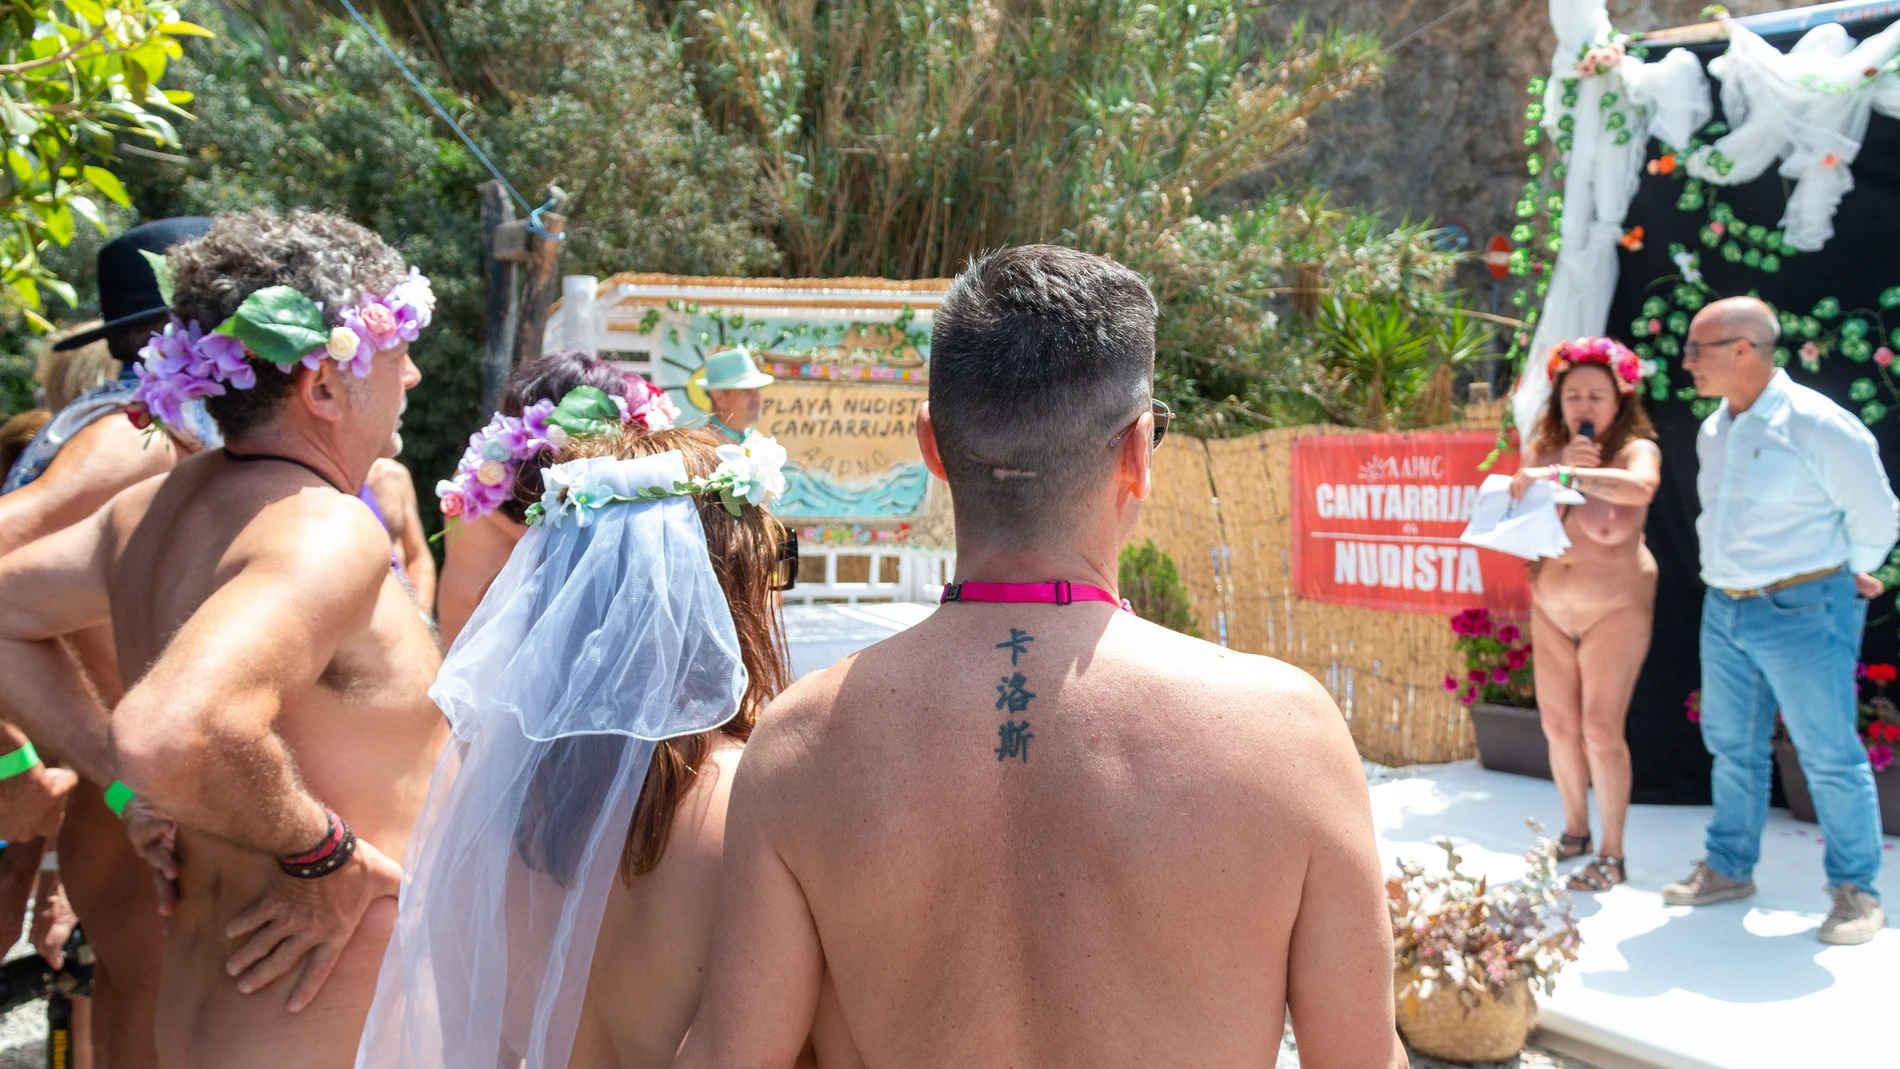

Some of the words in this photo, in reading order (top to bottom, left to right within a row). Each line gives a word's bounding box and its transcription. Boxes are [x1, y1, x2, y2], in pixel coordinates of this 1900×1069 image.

[762, 397, 832, 415] PLAYA
[844, 397, 922, 415] NUDIST
[1315, 482, 1478, 523] CANTARRIJA
[1334, 541, 1484, 594] NUDISTA
[994, 628, 1036, 764] 卡洛斯
